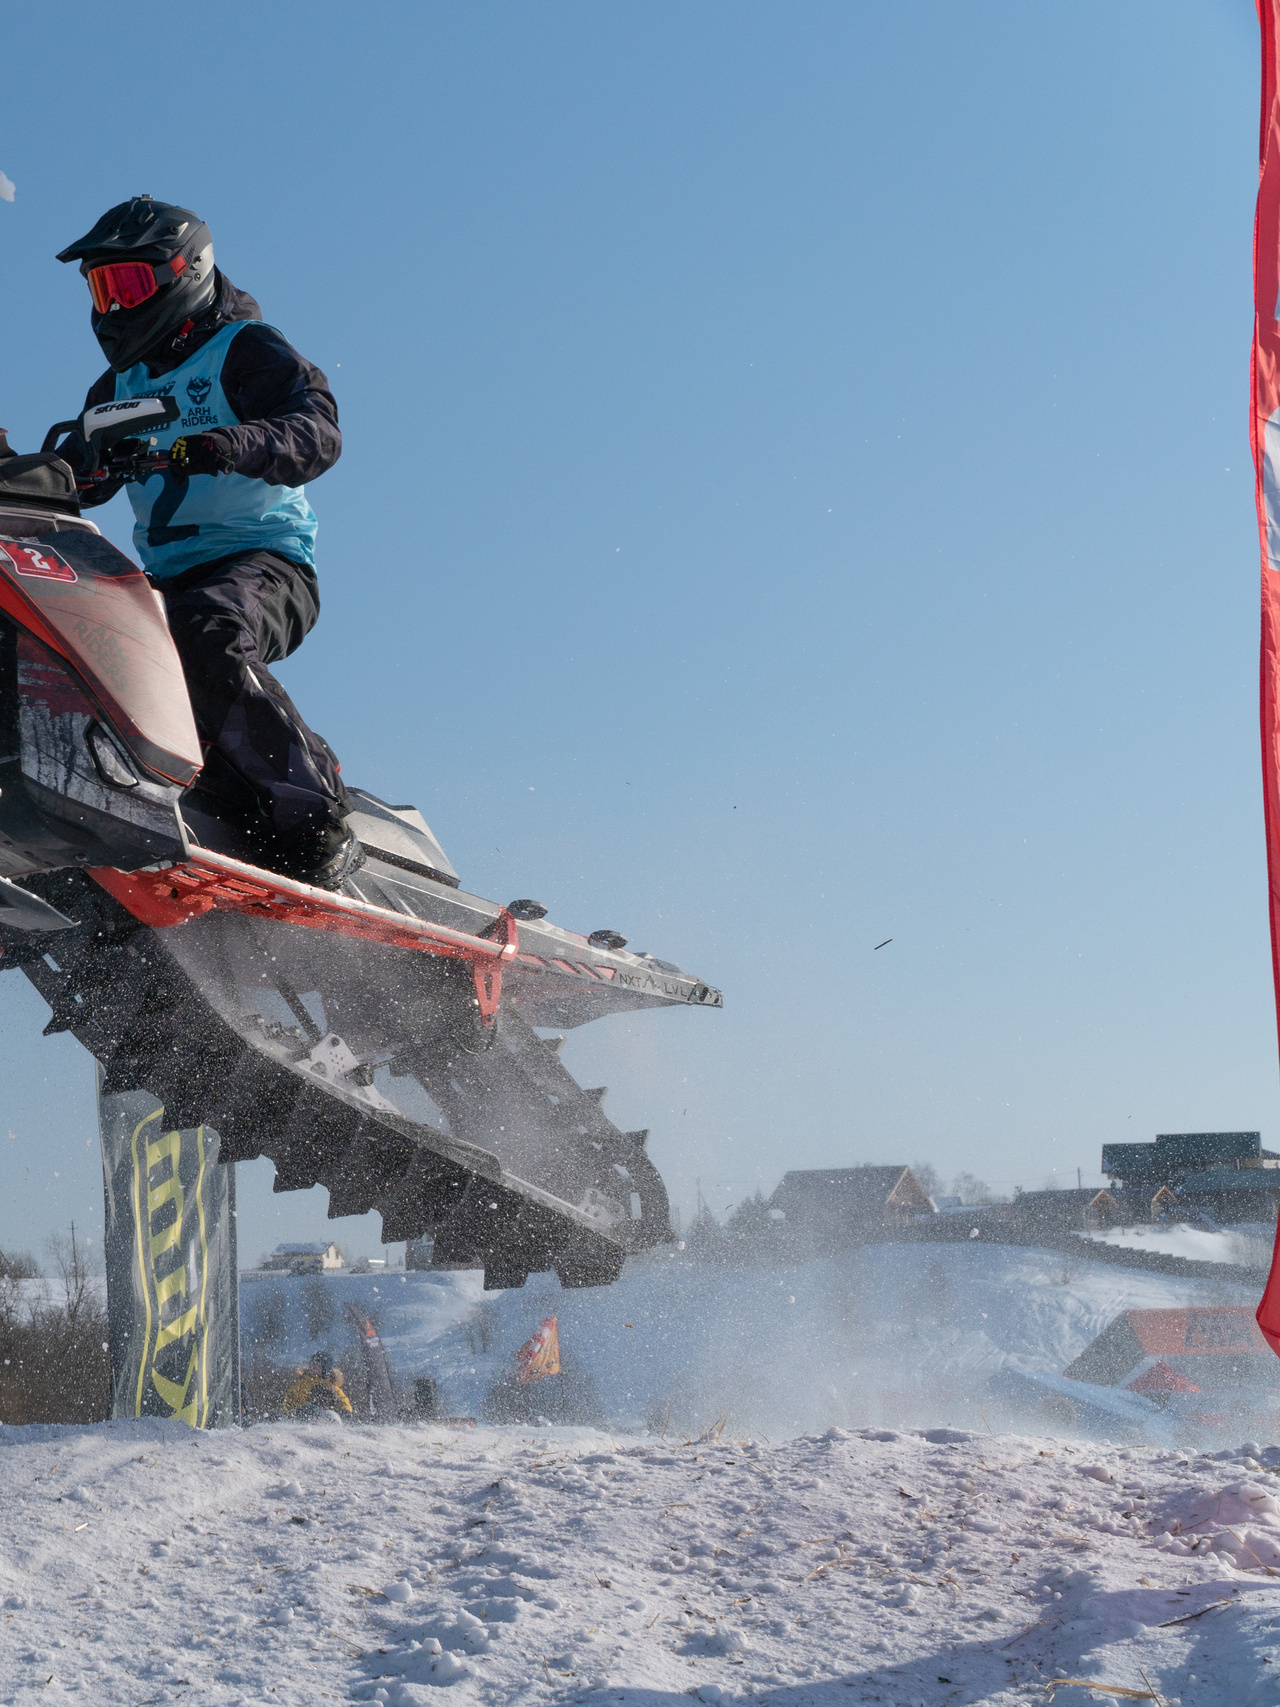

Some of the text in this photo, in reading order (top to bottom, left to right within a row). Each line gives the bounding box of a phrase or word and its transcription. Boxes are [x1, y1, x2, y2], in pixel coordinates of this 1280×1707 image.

[181, 415, 218, 428] RIDERS
[187, 406, 211, 417] ARH
[136, 449, 200, 547] 2
[23, 547, 51, 570] 2
[72, 620, 128, 692] RIDERS
[91, 624, 130, 668] ARH
[619, 972, 642, 986] NXT
